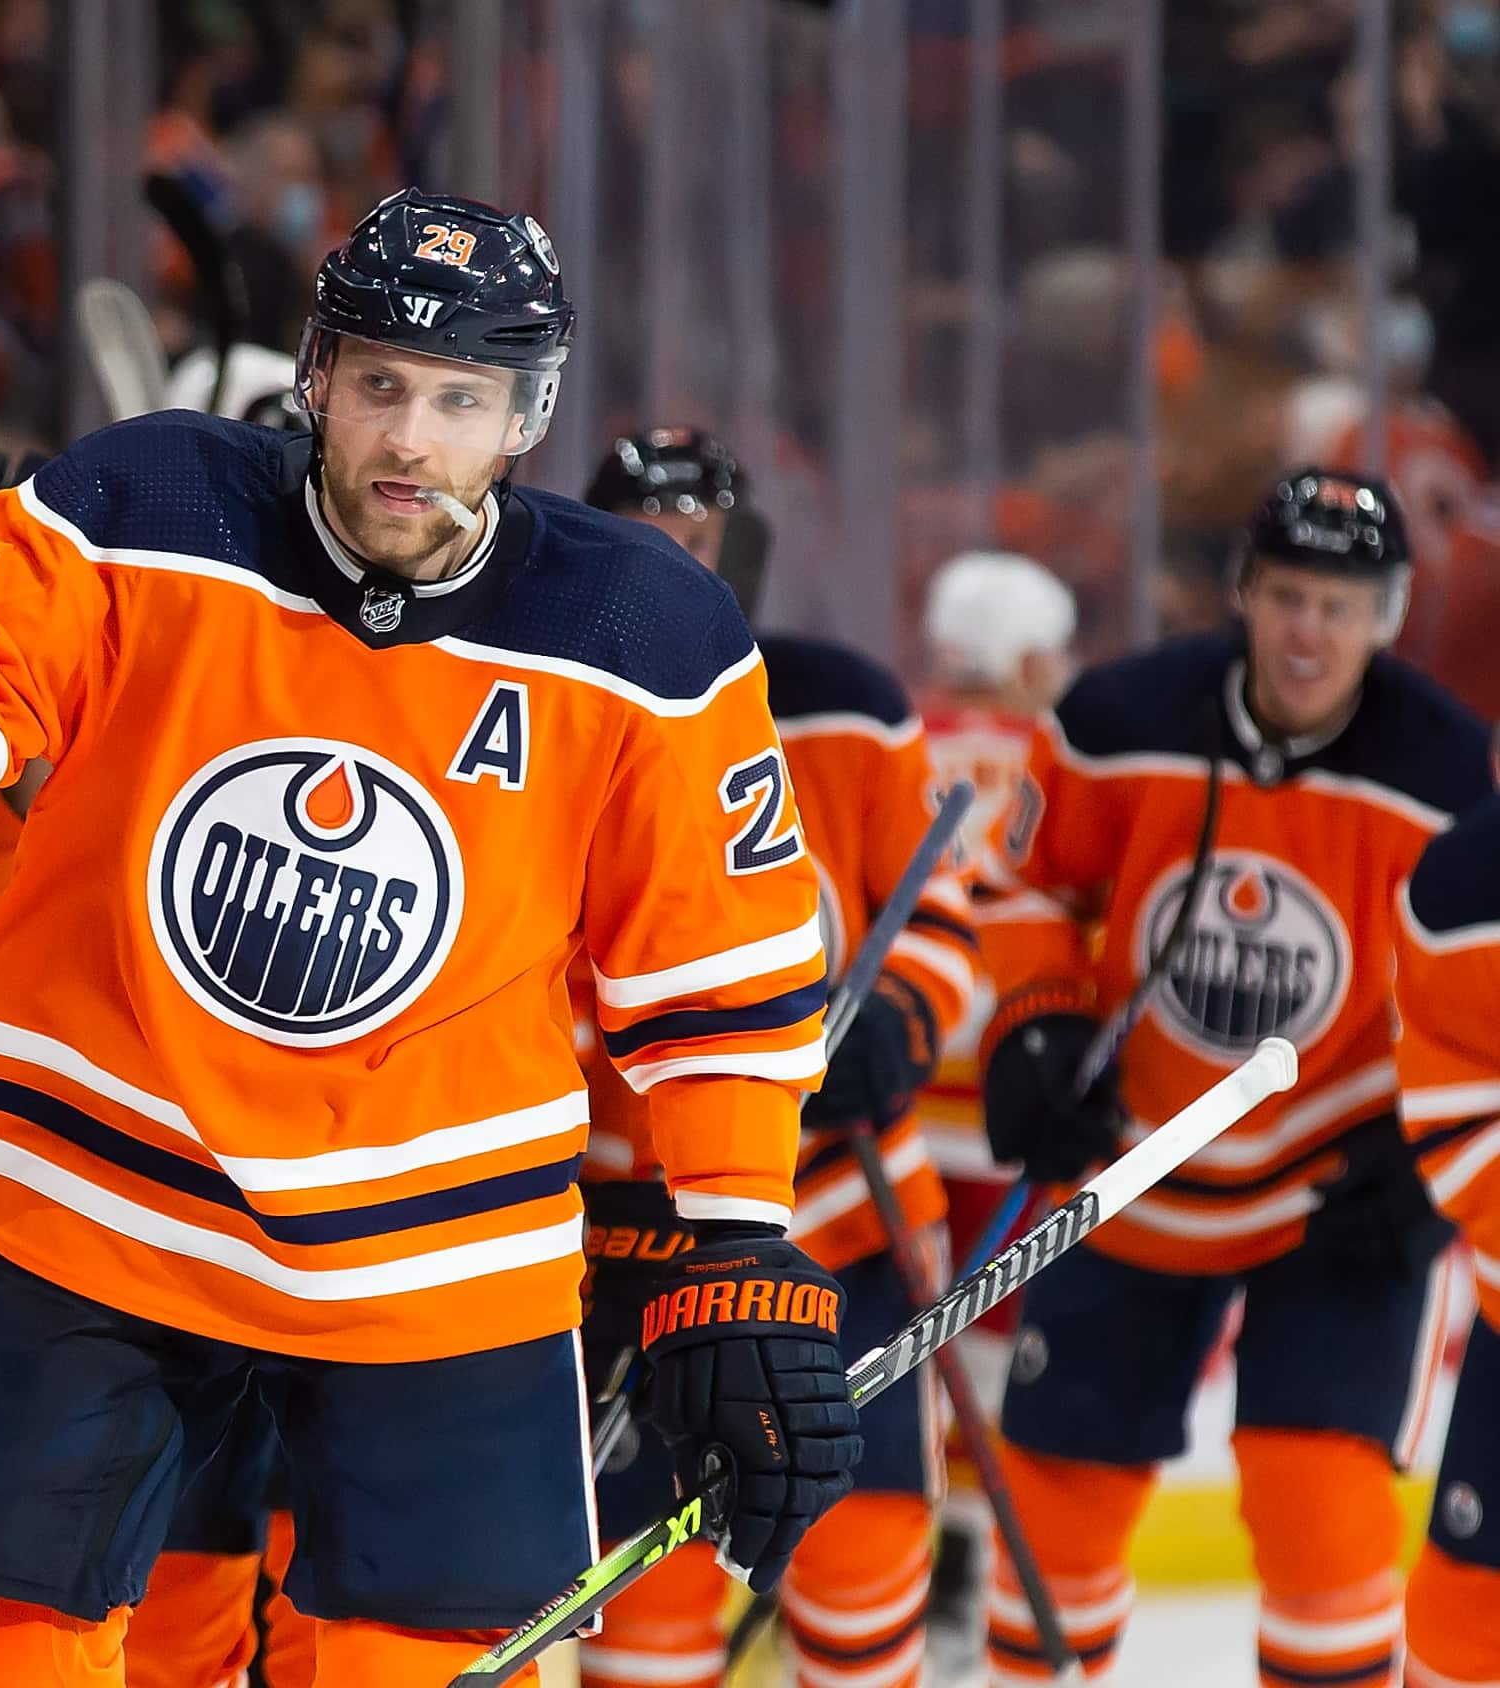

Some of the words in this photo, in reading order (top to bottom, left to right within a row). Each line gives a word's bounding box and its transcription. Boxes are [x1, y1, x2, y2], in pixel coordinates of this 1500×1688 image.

[414, 224, 477, 267] 29
[367, 601, 396, 620] NHL
[445, 679, 530, 792] A
[191, 821, 418, 1017] OILERS
[642, 1279, 838, 1352] WARRIOR
